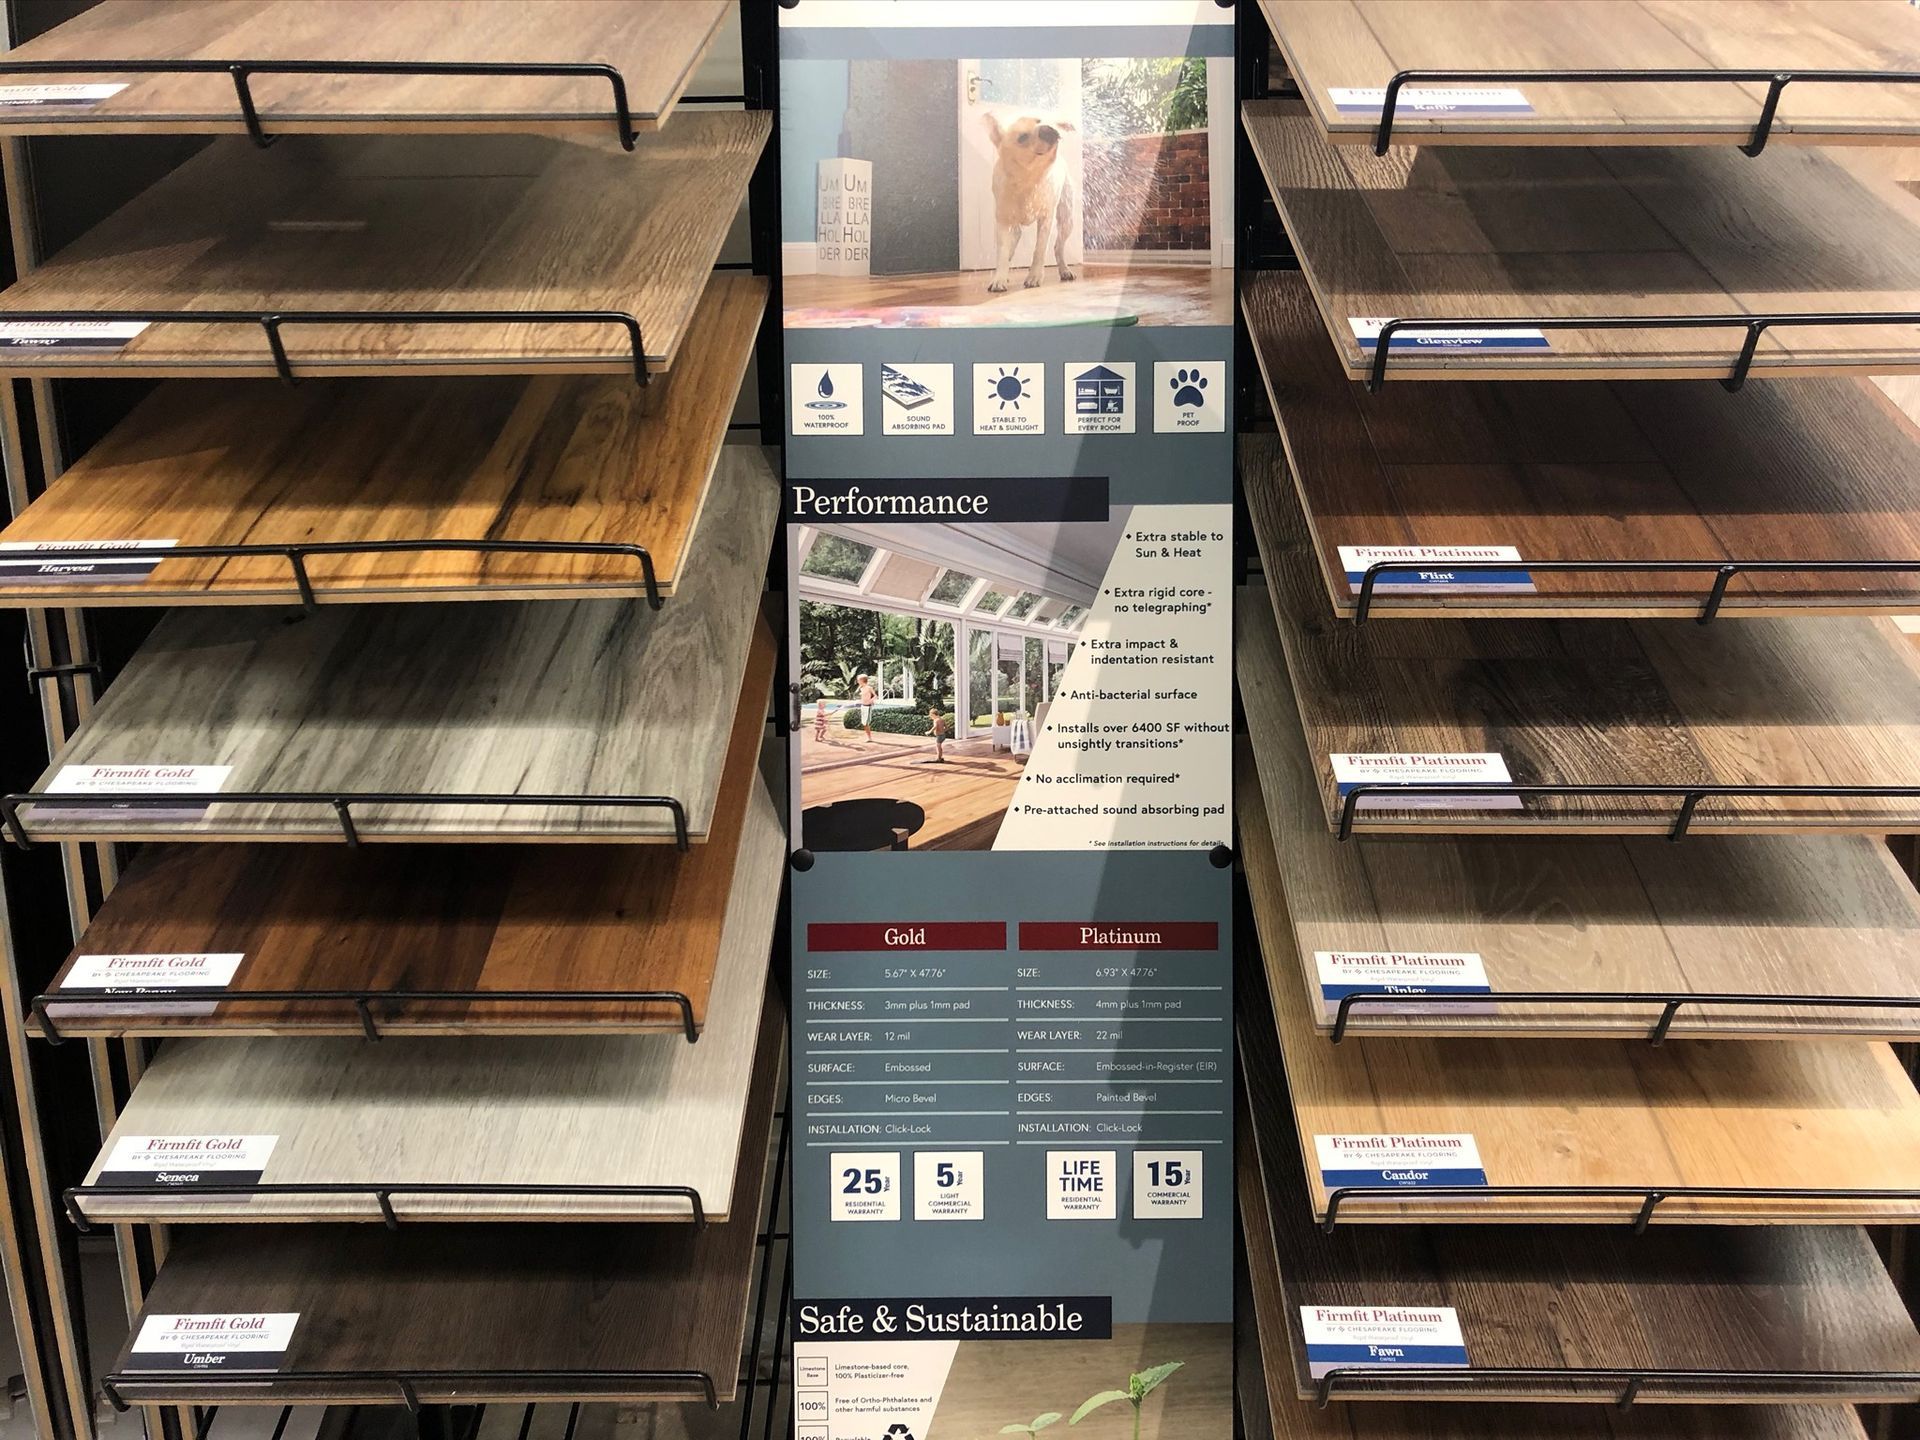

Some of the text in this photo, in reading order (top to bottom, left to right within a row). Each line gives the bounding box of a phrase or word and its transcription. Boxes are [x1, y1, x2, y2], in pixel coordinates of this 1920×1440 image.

[849, 197, 869, 210] BRE
[847, 212, 869, 224] LLA
[845, 248, 868, 261] DER
[793, 487, 988, 516] Performance
[1136, 531, 1223, 541] Extra stable to
[1136, 548, 1201, 557] Sun & Heat
[1115, 588, 1144, 598] Extra
[1149, 587, 1175, 600] rigid
[1092, 639, 1178, 651] Extra impact &
[1091, 655, 1214, 665] indentation resistant
[1071, 689, 1197, 699] Anti-bacterial surface
[1058, 723, 1099, 733] Installs
[1132, 723, 1161, 733] 6400
[1167, 723, 1179, 733] SF
[1184, 722, 1229, 732] without
[1058, 738, 1111, 751] unsightly
[1348, 756, 1487, 765] Firmfit Platinum
[92, 769, 194, 778] Firmfit Gold
[1036, 774, 1052, 784] No
[1056, 774, 1122, 784] acclimation
[1025, 804, 1224, 817] Pre-attached sound absorbing pad
[885, 928, 925, 945] Gold
[1080, 928, 1161, 944] Platinum
[108, 957, 206, 968] Firmfit Gold
[1331, 954, 1464, 966] Firmfit Platinum
[808, 970, 831, 978] SIZE:
[1017, 969, 1040, 977] SIZE:
[808, 1002, 865, 1010] THICKNESS:
[910, 1001, 927, 1011] plus
[931, 1001, 950, 1009] 1mm
[953, 1001, 970, 1011] pad
[1017, 1000, 1181, 1010] THICKNESS: 4mm plus 1mm pad
[808, 1032, 910, 1041] WEAR LAYER: 12 mil
[1017, 1032, 1046, 1040] WEAR
[1050, 1031, 1082, 1040] LAYER:
[808, 1063, 931, 1072] SURFACE: Embossed
[1018, 1063, 1217, 1072] SURFACE: Embossed-in-Register (EIR)
[808, 1095, 936, 1104] EDGES: Micro Bevel
[1018, 1093, 1156, 1102] EDGES: Painted Bevel
[808, 1125, 931, 1134] INSTALLATION: Click-Lock
[1018, 1124, 1142, 1132] INSTALLATION: Click-Lock
[147, 1139, 242, 1150] Firmfit Gold
[1332, 1137, 1462, 1148] Firmfit Platinum
[1063, 1161, 1100, 1174] LIFE
[156, 1173, 199, 1182] Seneca
[937, 1163, 954, 1187] 5
[1148, 1162, 1183, 1186] 15
[1382, 1171, 1428, 1180] Candor
[843, 1168, 882, 1194] 25
[1059, 1178, 1103, 1191] TIME
[800, 1305, 1083, 1334] Safe & Sustainable
[1316, 1310, 1442, 1322] Firmfit Platinum
[174, 1318, 265, 1329] Firmfit Gold
[1368, 1346, 1404, 1356] Fawn
[184, 1354, 225, 1363] Umber
[801, 1402, 825, 1410] 100%
